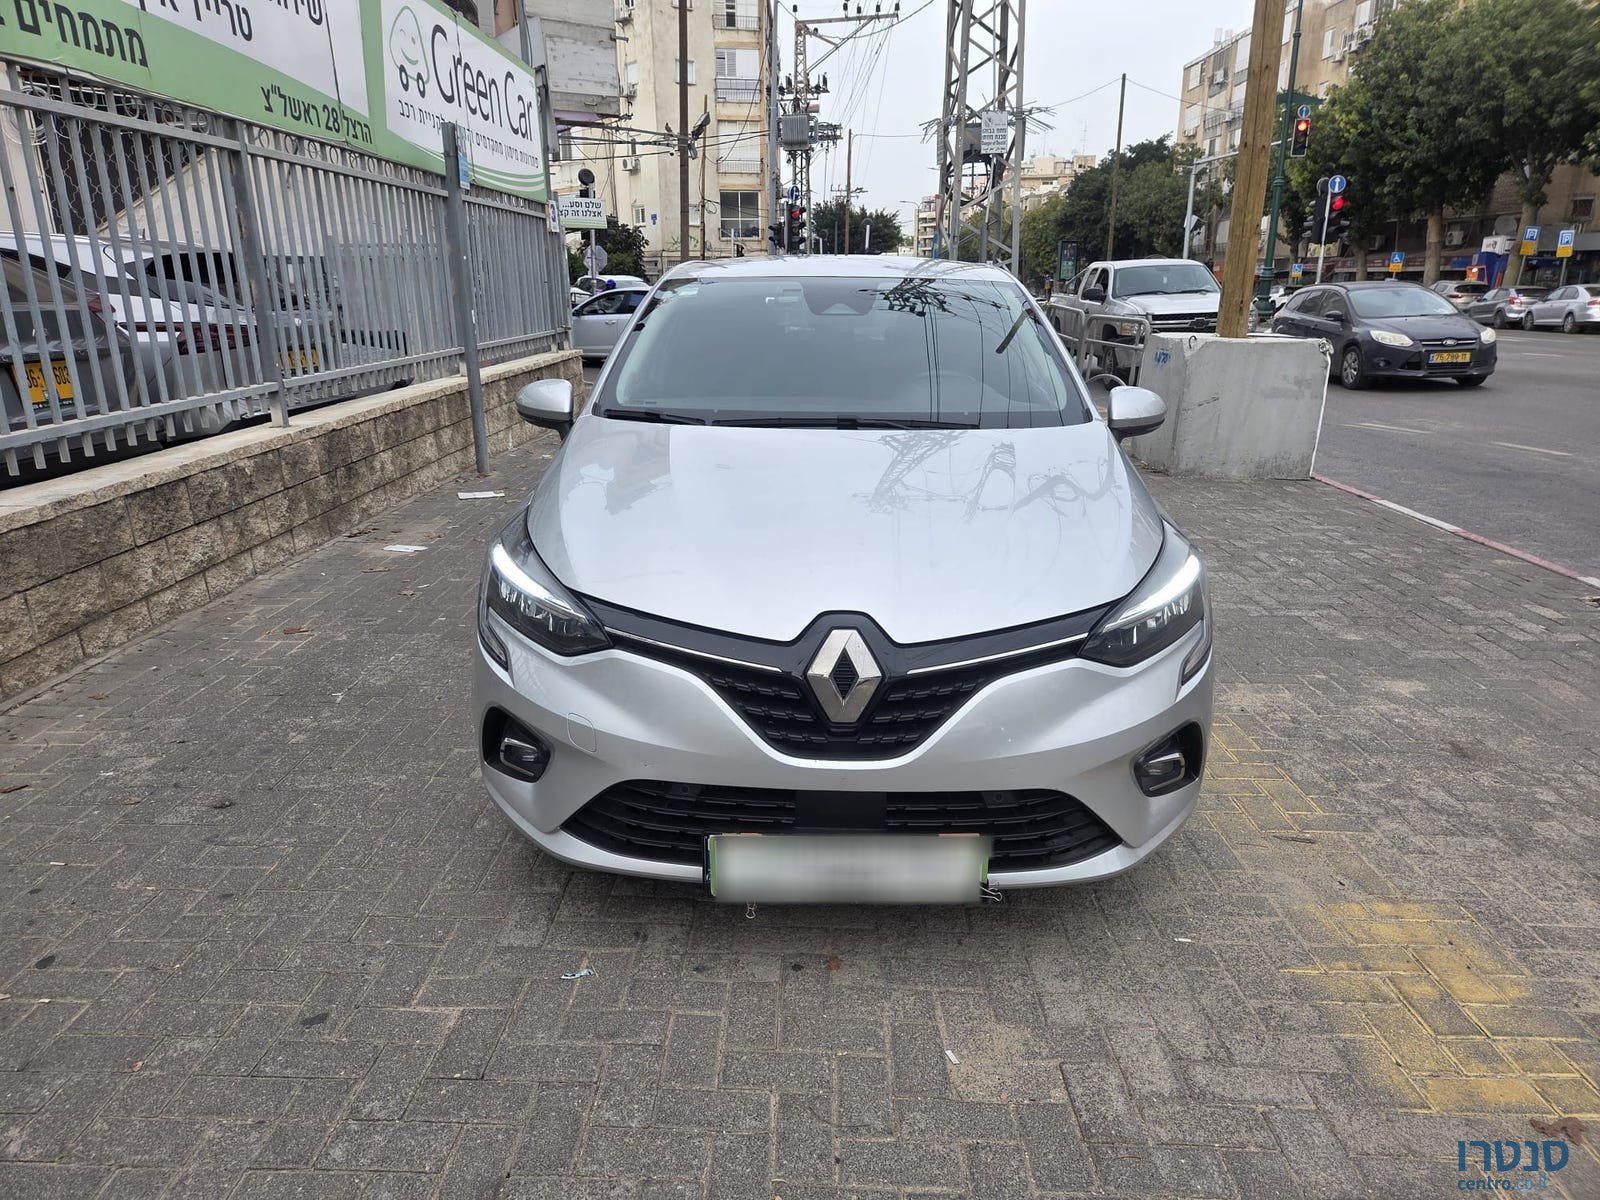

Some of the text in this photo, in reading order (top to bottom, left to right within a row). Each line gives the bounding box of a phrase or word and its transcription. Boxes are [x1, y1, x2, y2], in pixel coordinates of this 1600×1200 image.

[14, 0, 148, 68] מתמחים
[431, 24, 533, 142] Green Car
[322, 104, 341, 133] 28
[398, 99, 416, 121] רכב
[341, 109, 373, 144] הרצל
[581, 209, 602, 217] אצלנו
[585, 200, 602, 209] שלם
